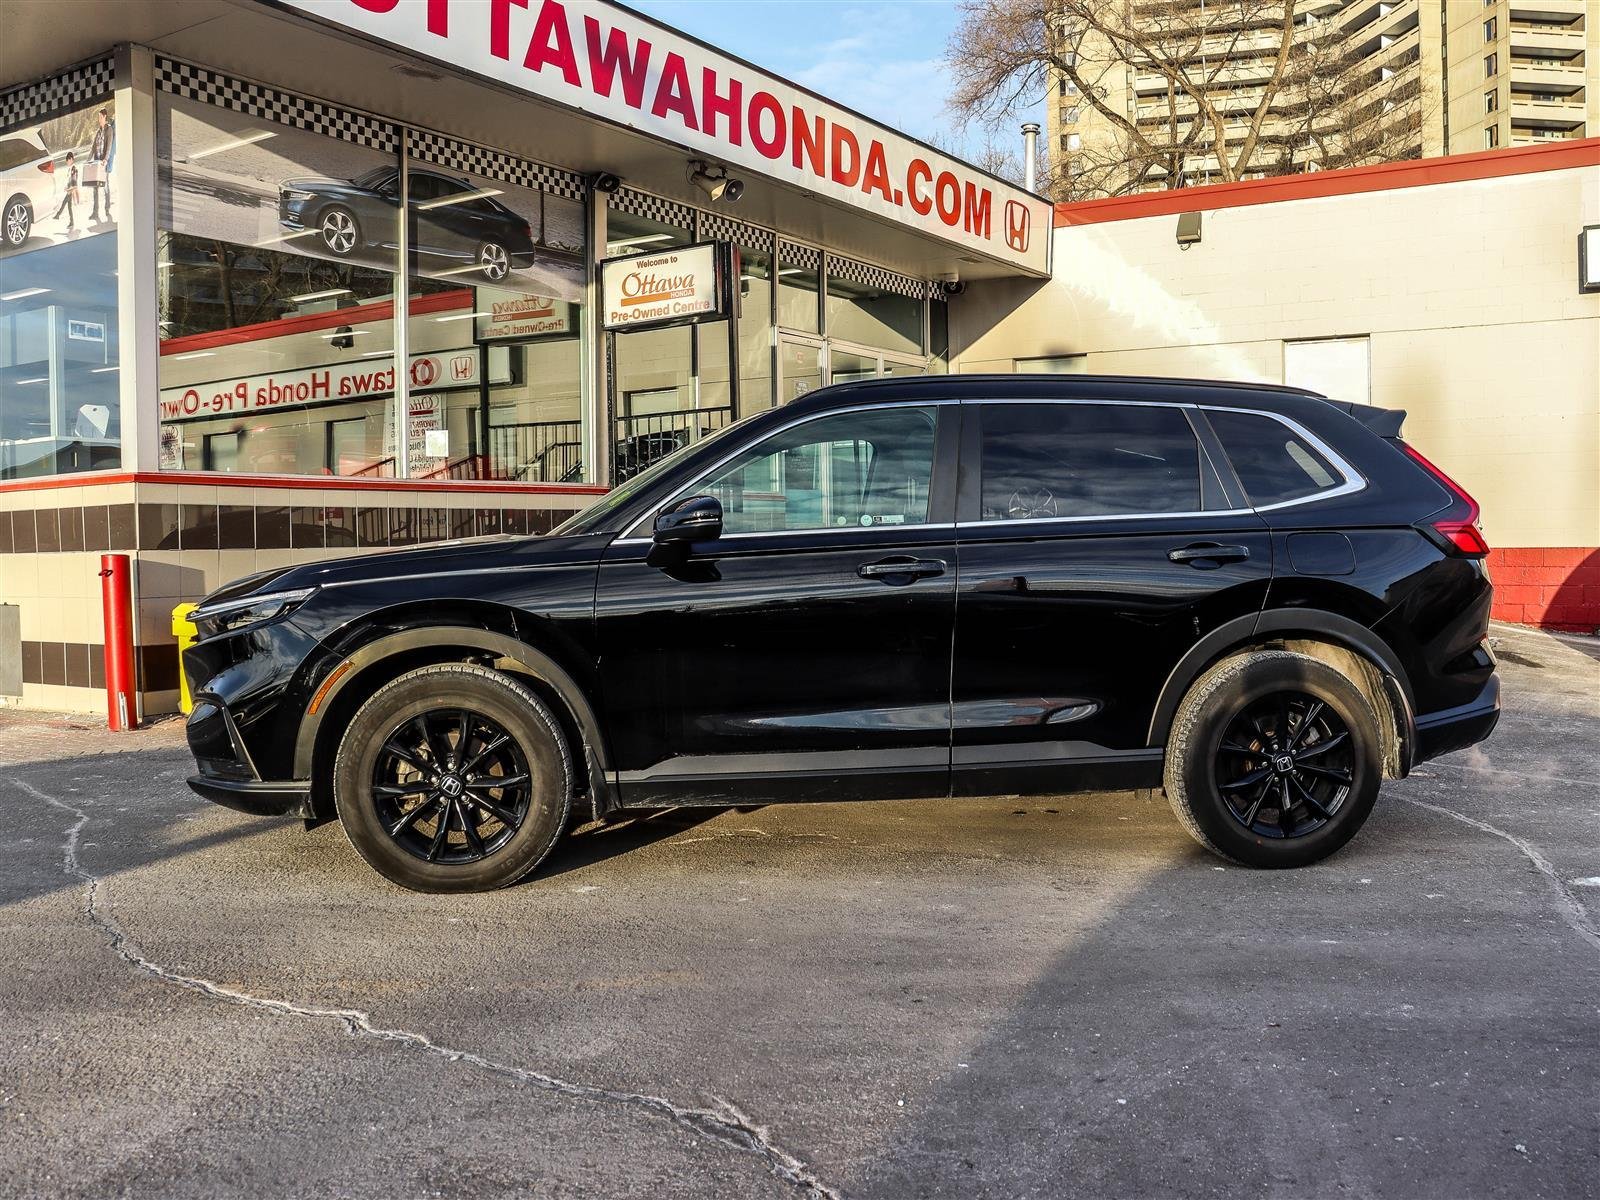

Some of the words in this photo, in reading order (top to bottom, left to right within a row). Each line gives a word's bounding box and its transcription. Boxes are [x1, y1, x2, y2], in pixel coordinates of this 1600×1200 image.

[348, 0, 992, 241] TAWAHONDA.COM
[637, 258, 669, 269] Welcome
[670, 255, 678, 263] to
[621, 272, 695, 297] Ottawa
[670, 289, 693, 298] HONDA
[611, 303, 670, 323] Pre-Owned
[673, 300, 710, 313] Centre
